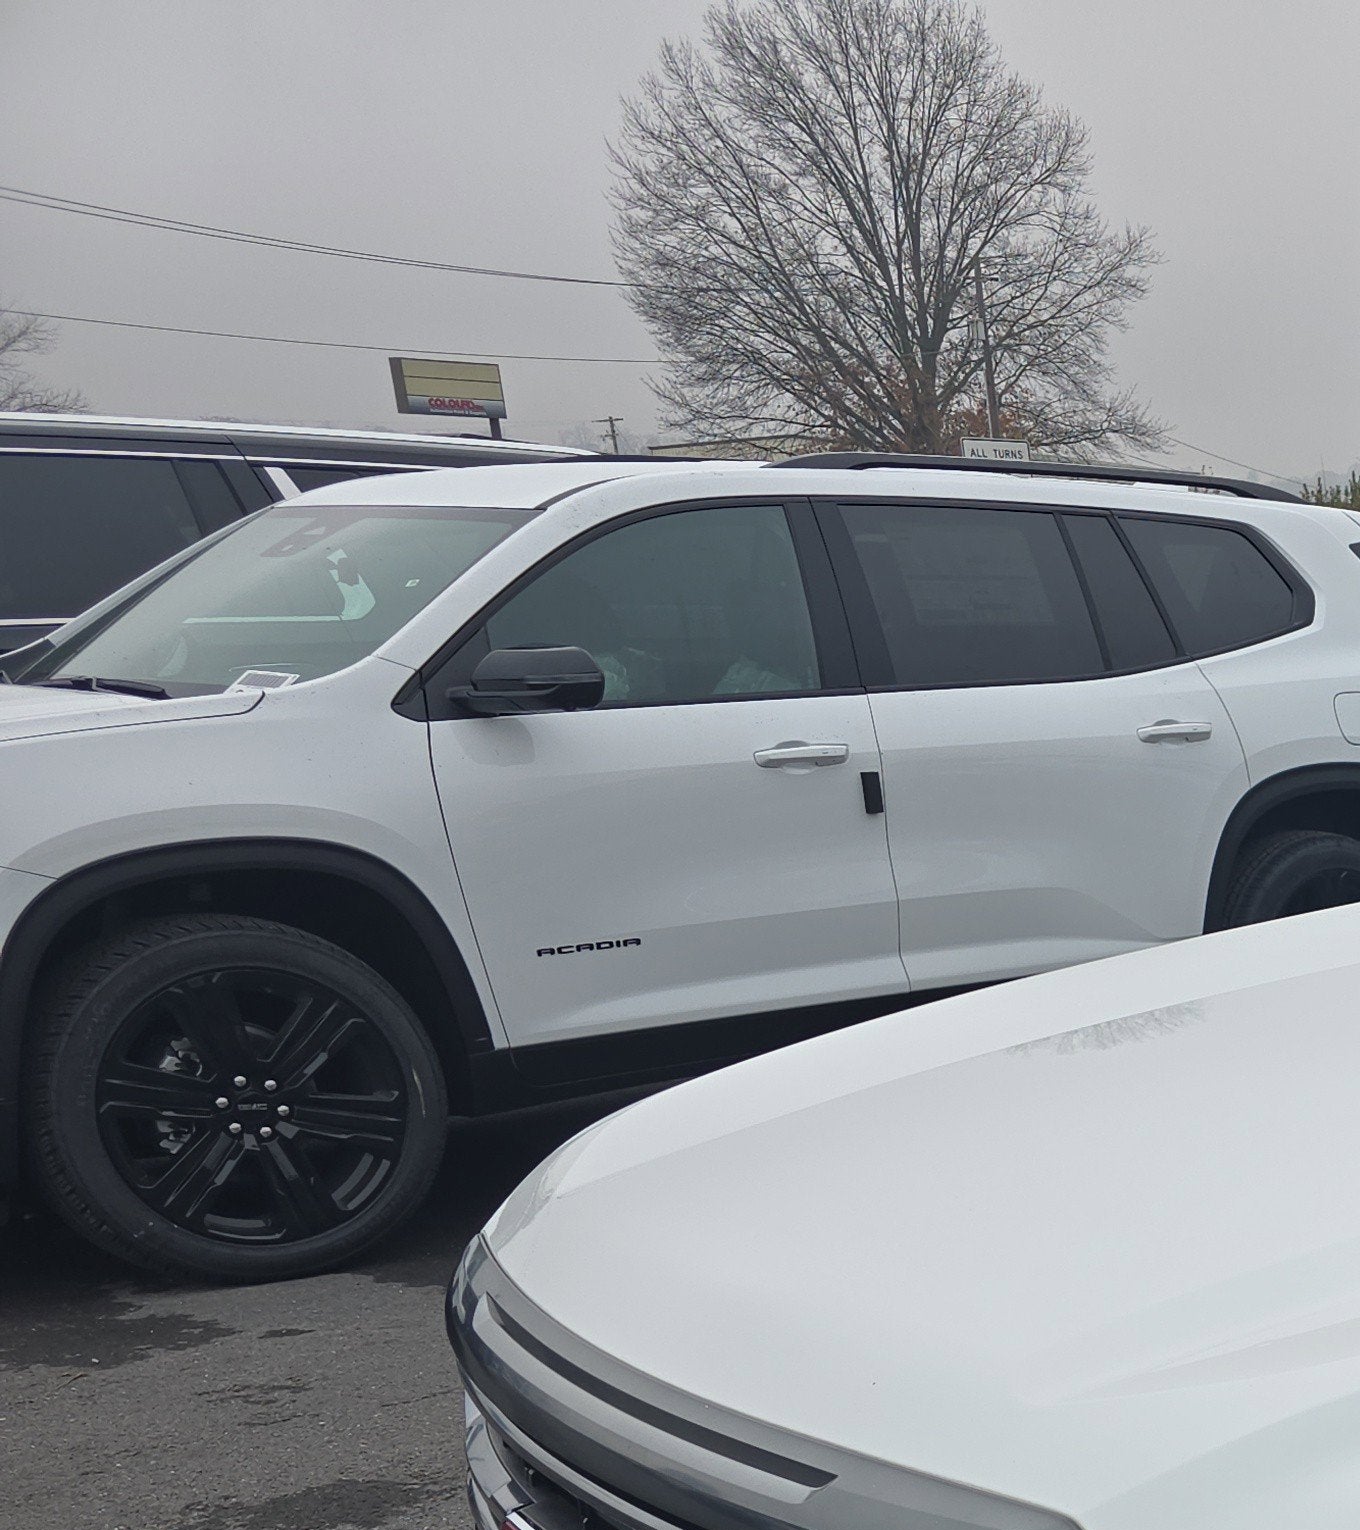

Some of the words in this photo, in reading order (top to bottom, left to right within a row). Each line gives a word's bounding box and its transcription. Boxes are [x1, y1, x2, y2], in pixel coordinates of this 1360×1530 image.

[970, 448, 988, 458] ALL
[993, 448, 1023, 460] TURNS
[536, 938, 642, 957] ACADIA
